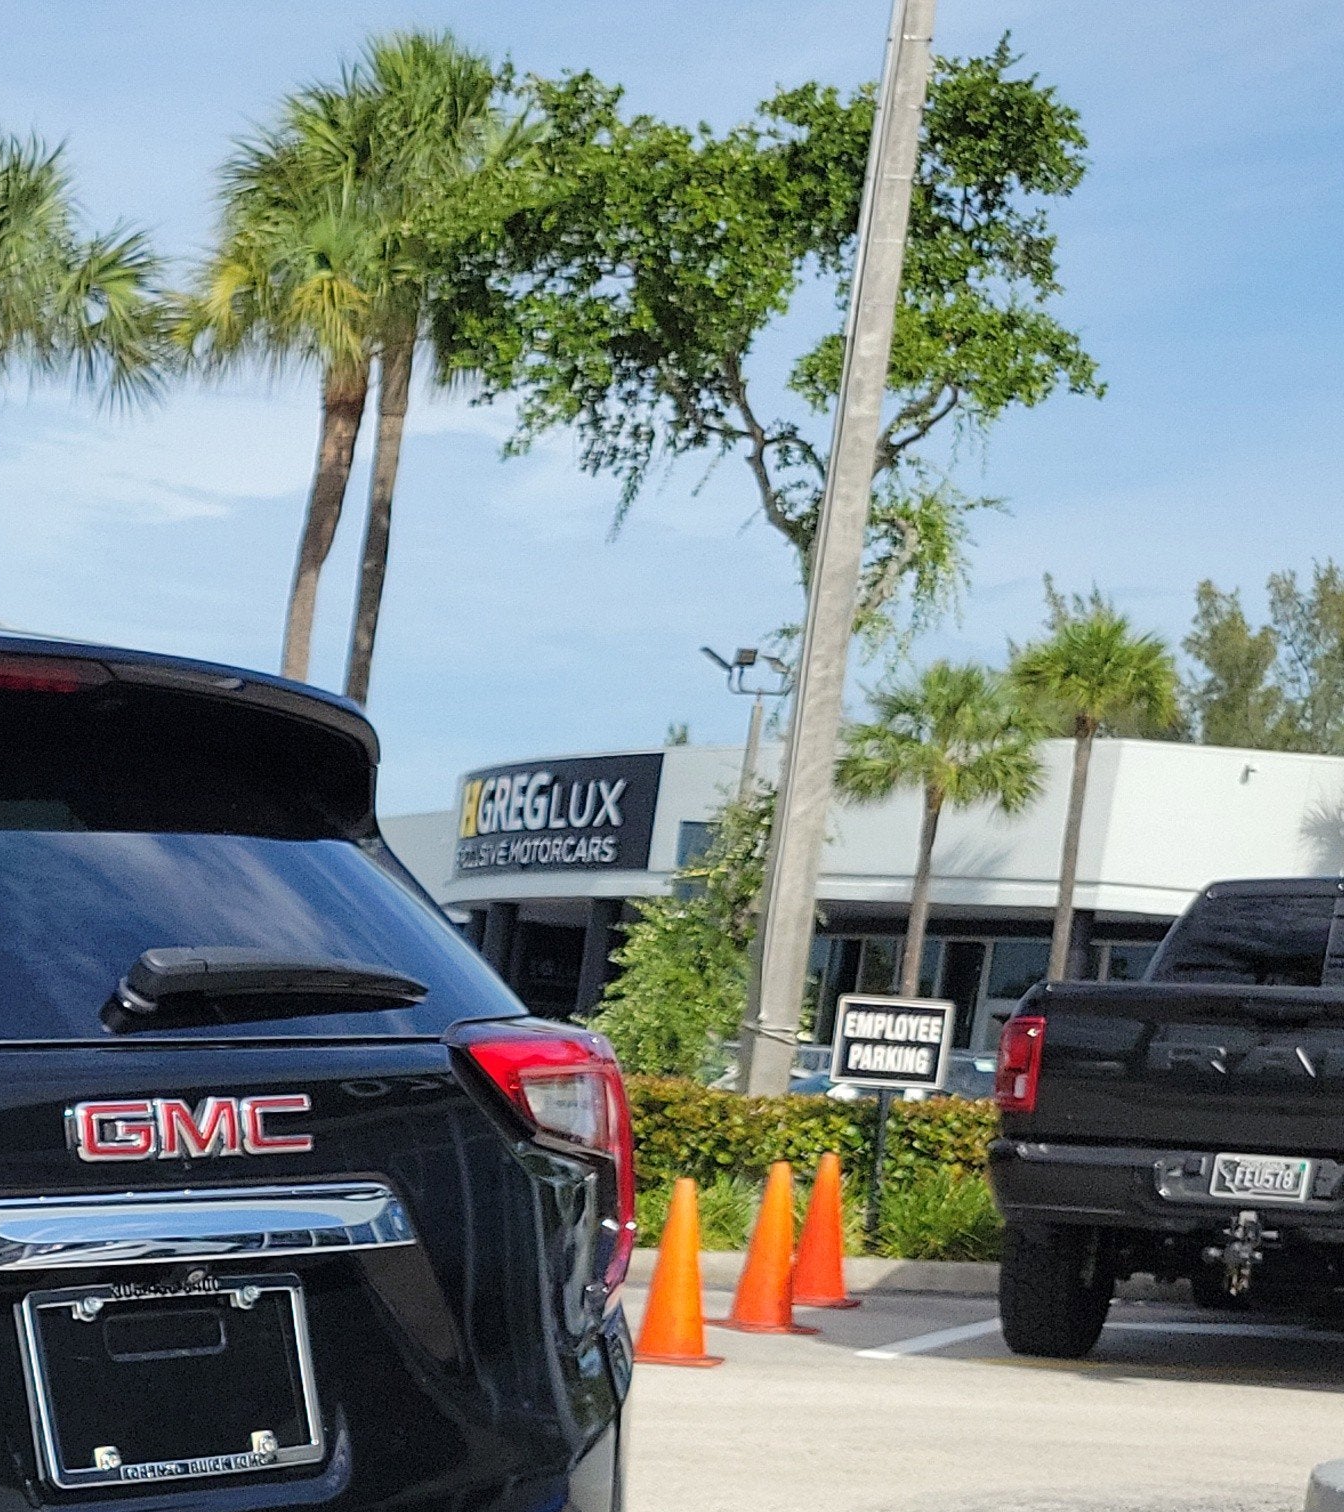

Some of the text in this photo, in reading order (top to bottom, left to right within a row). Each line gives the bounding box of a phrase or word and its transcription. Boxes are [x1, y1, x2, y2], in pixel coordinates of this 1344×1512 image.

[844, 1011, 944, 1043] EMPLOYEE
[848, 1043, 934, 1074] PARKING
[69, 1093, 313, 1163] GMC
